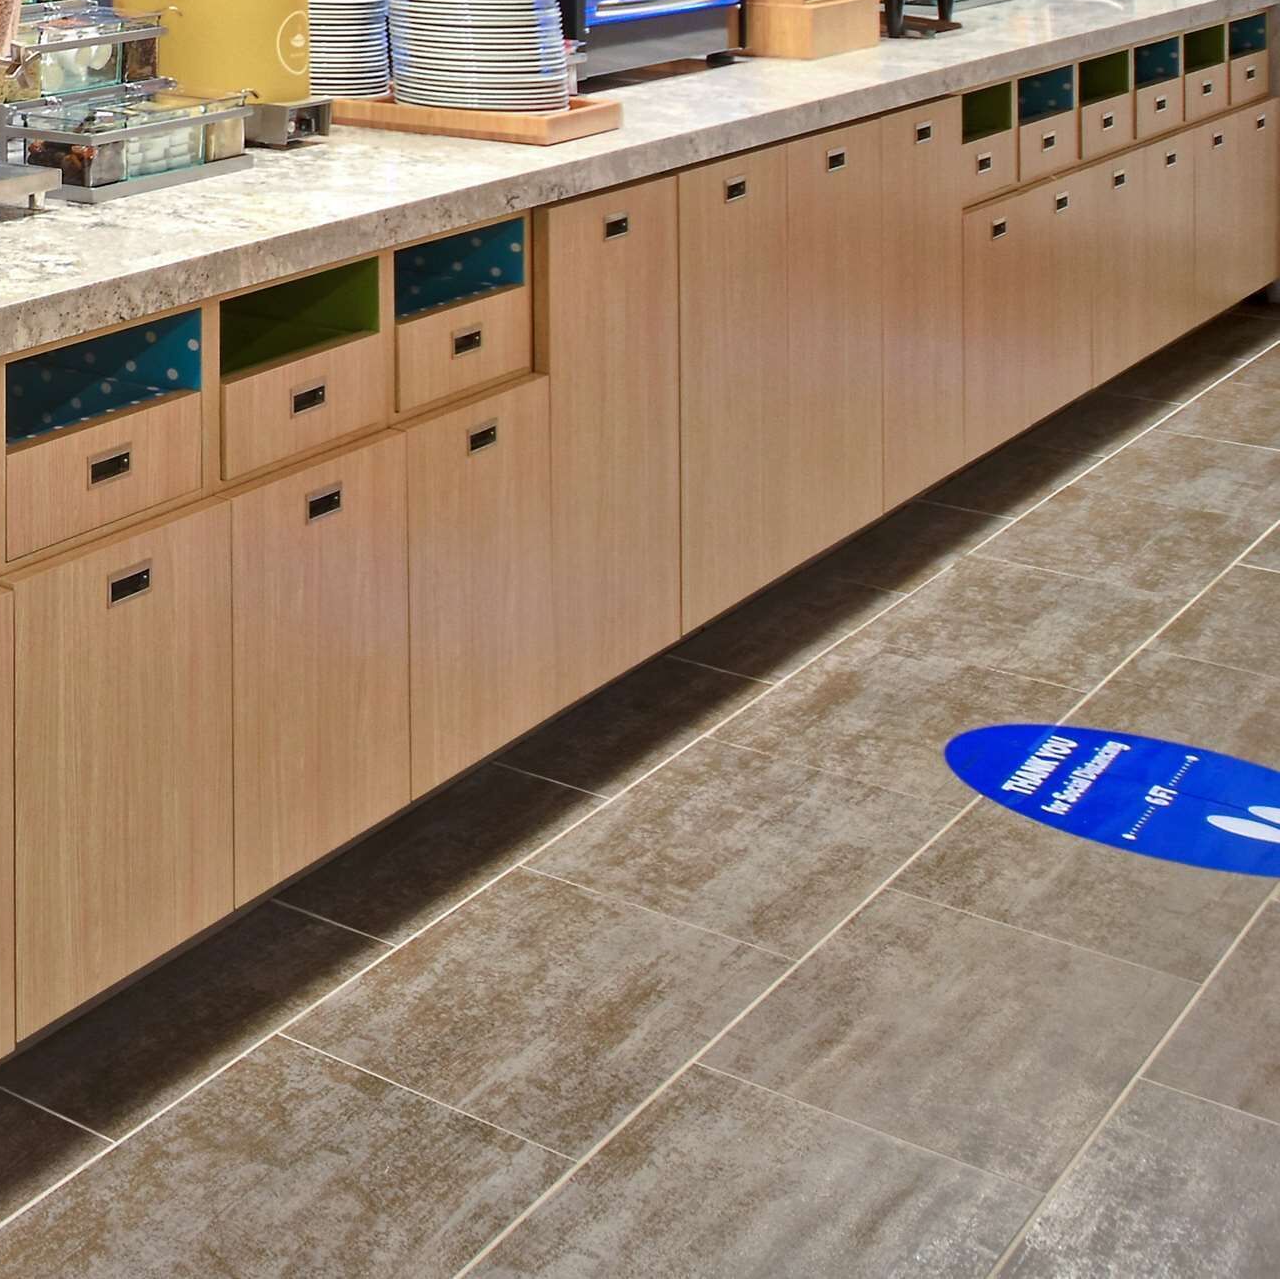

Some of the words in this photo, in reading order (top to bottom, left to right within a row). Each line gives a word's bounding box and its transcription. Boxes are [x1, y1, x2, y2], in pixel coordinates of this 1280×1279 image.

[1001, 755, 1061, 795] THANK
[1035, 735, 1079, 760] YOU
[1071, 740, 1132, 781] Distancing
[1051, 775, 1094, 802] Social
[1041, 799, 1072, 815] for
